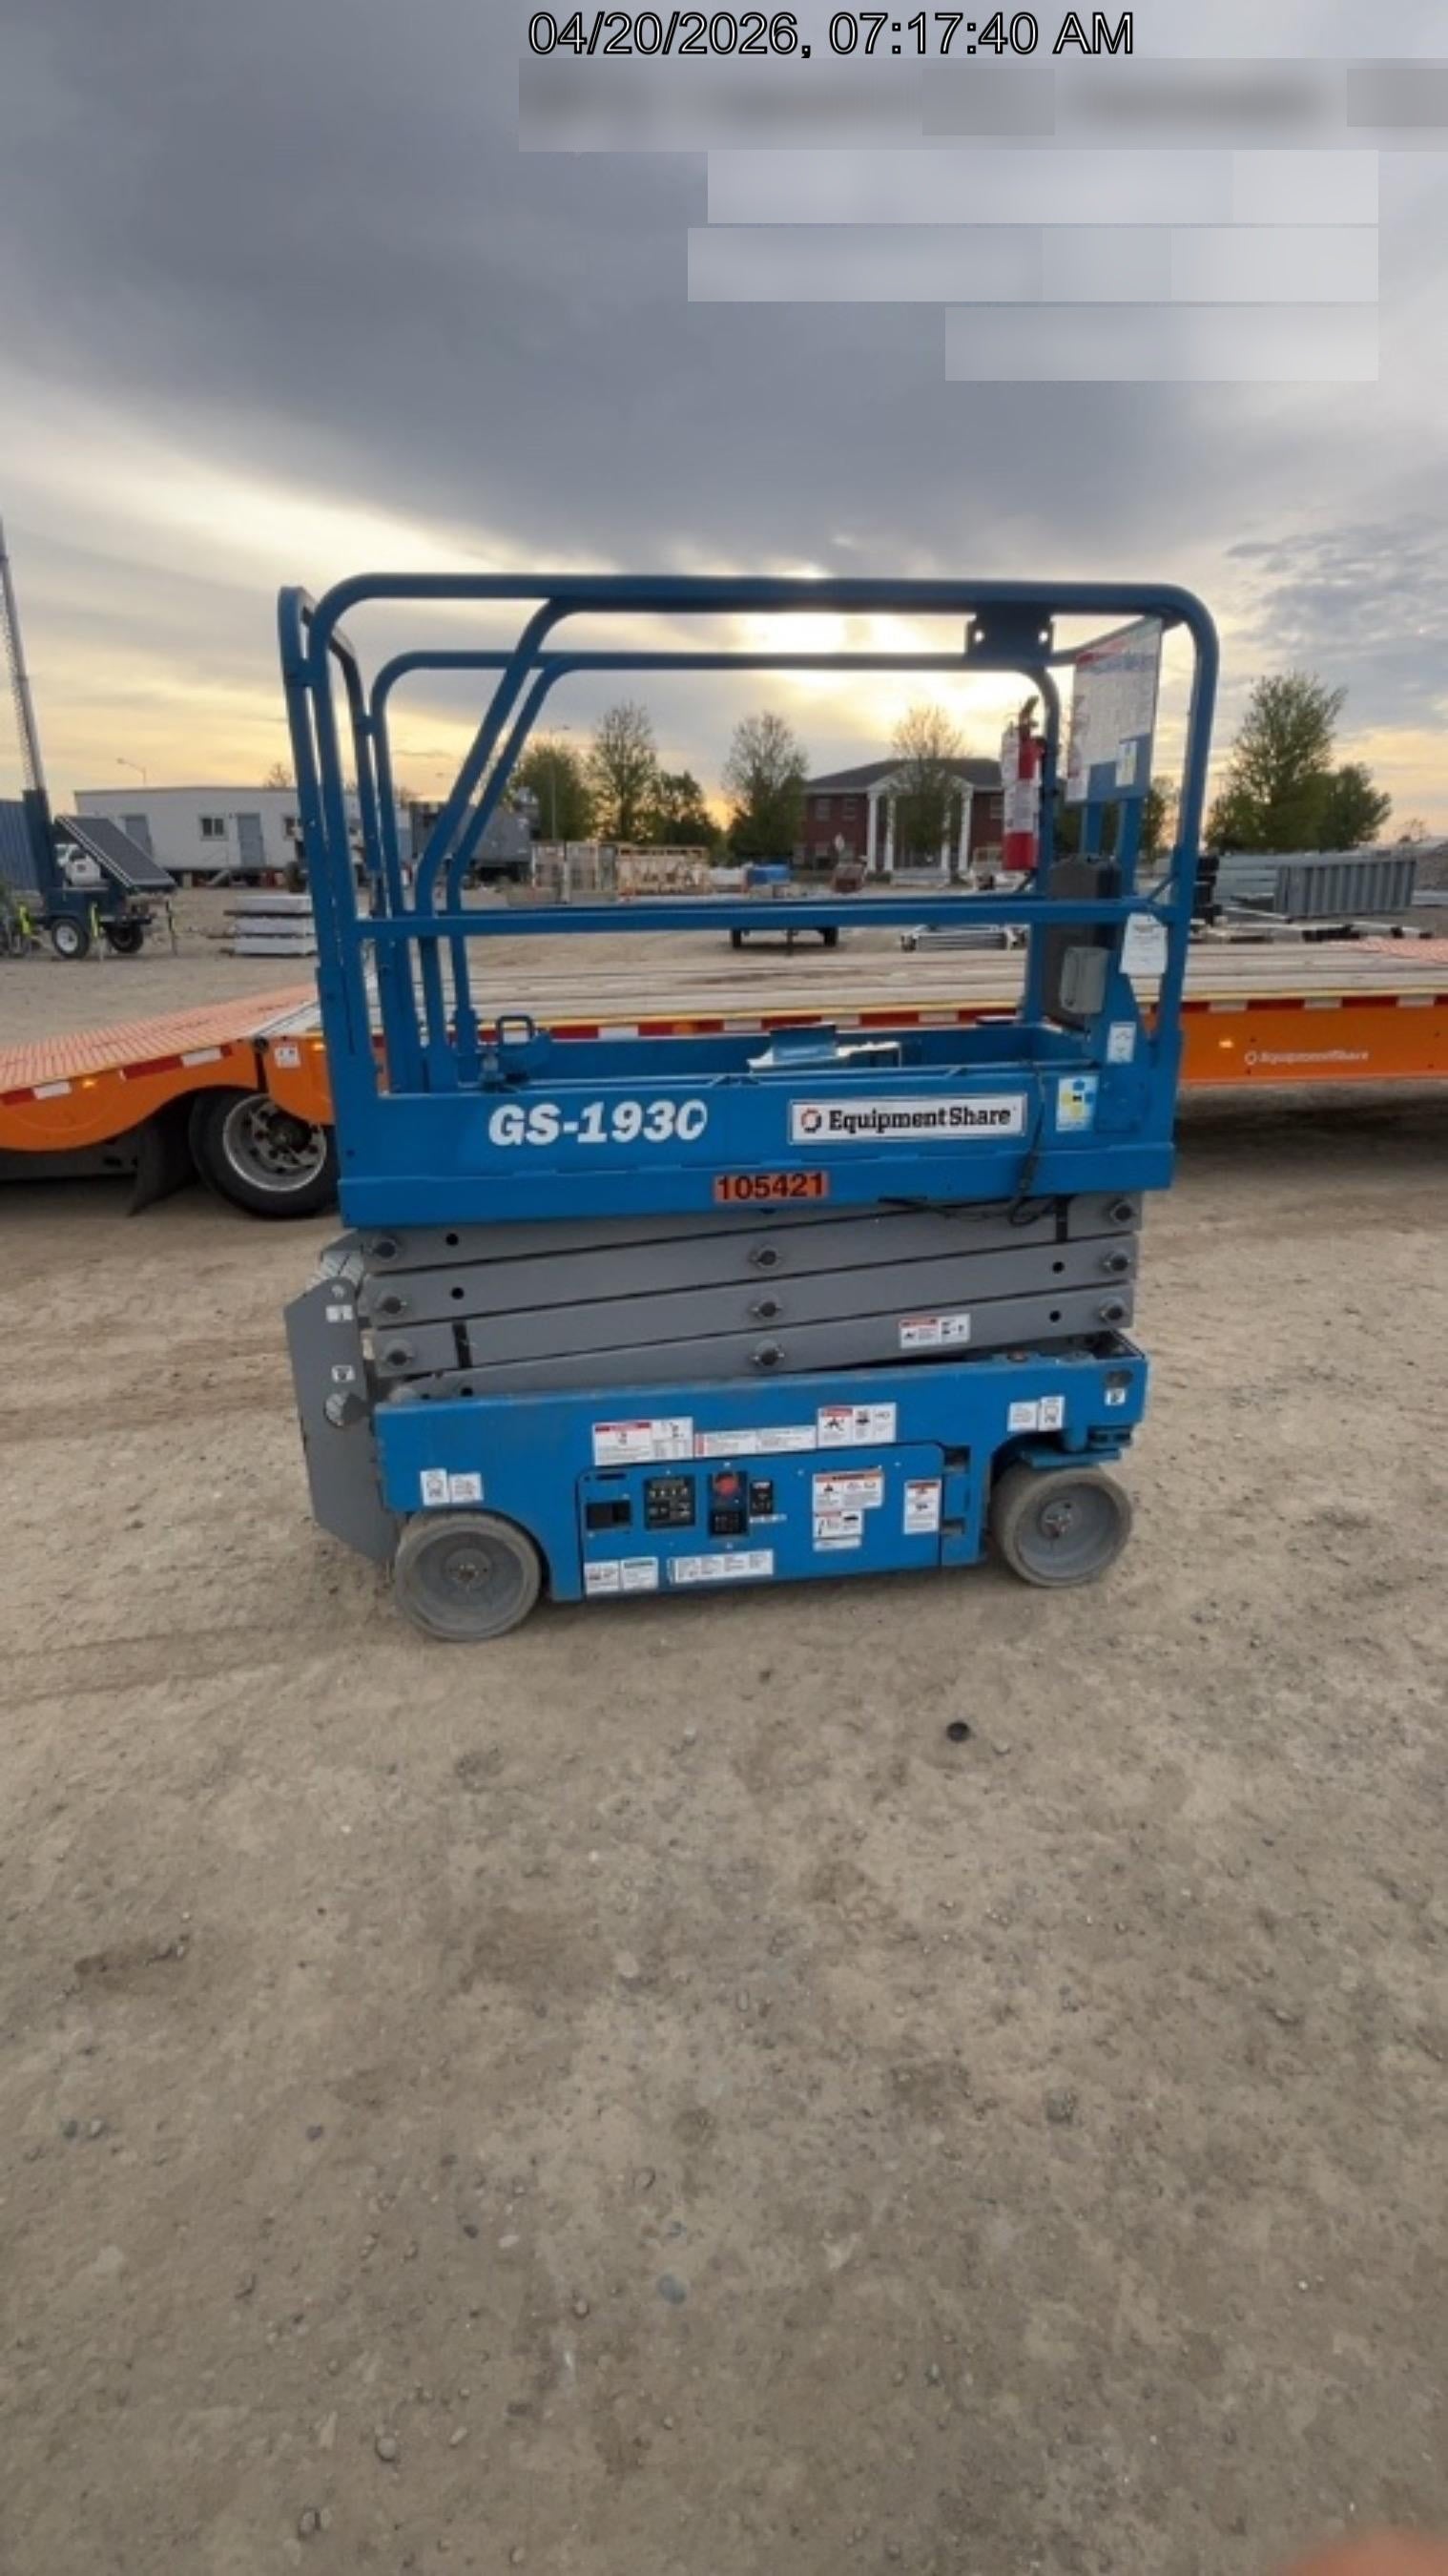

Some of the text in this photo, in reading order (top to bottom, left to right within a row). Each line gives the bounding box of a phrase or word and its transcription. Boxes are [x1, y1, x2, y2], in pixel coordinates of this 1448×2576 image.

[488, 1099, 708, 1146] GS-1930
[828, 1106, 1012, 1133] EquipmentShare
[717, 1173, 823, 1200] 105421
